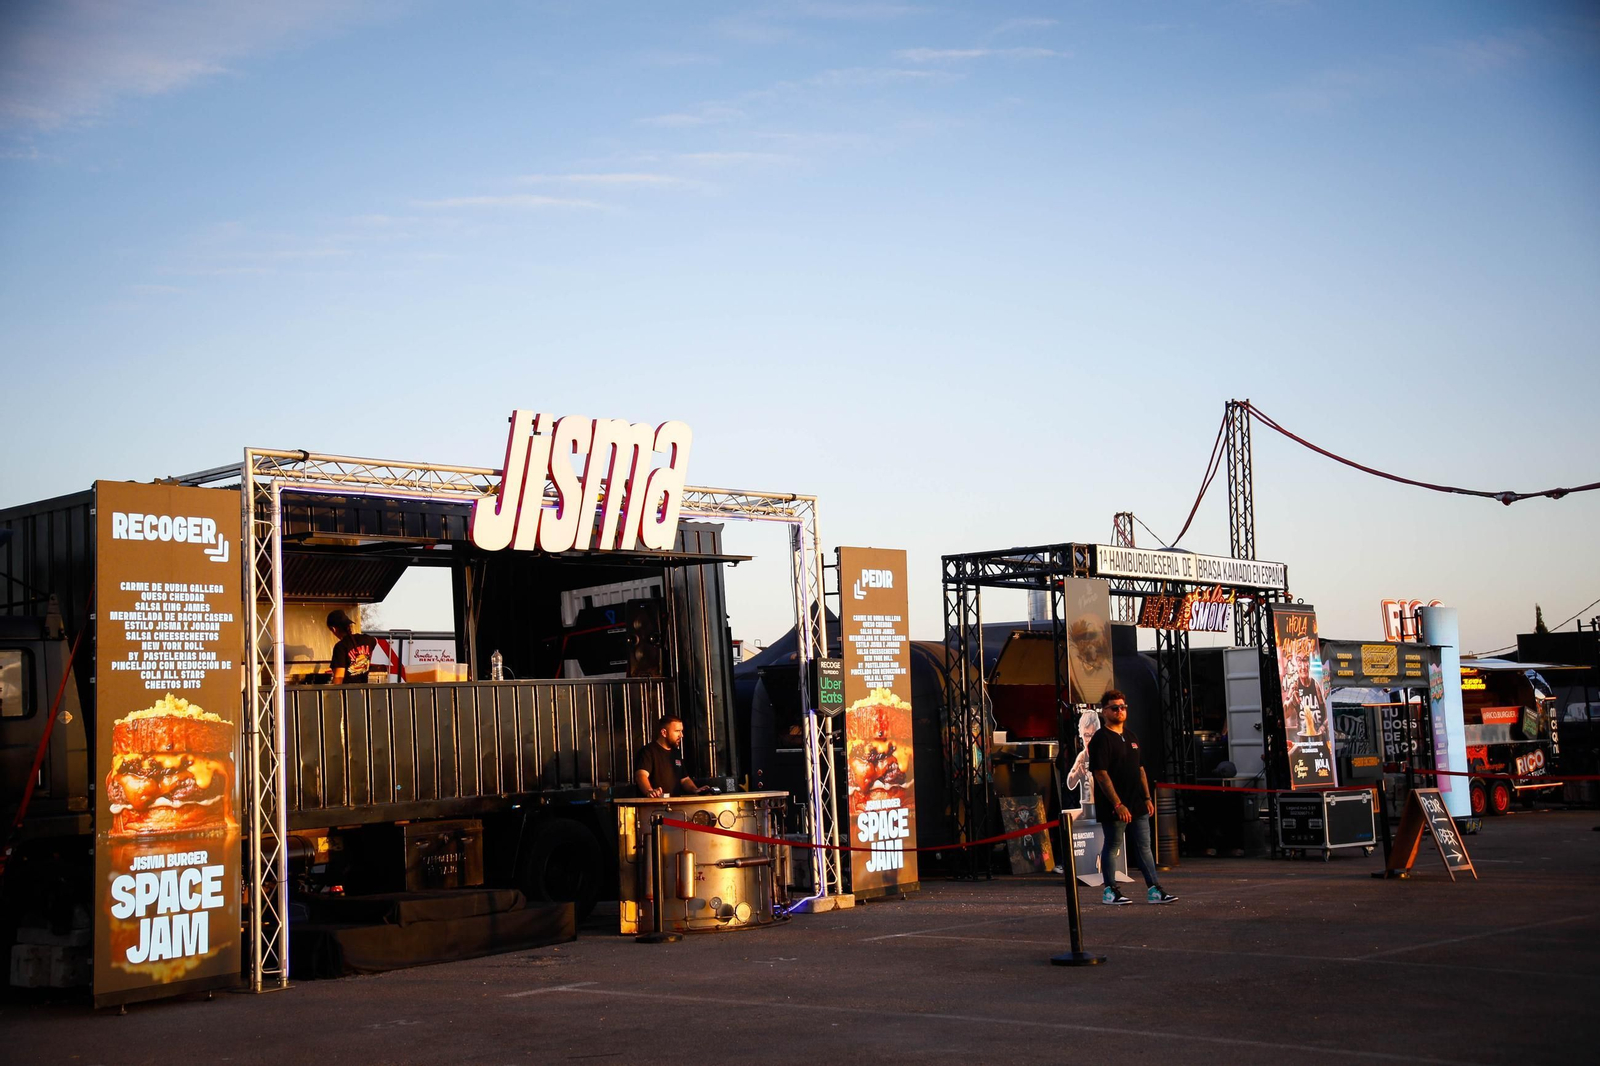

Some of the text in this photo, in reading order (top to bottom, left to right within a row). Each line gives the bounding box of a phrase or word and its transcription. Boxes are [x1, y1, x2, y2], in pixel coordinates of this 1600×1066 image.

[112, 512, 216, 544] RECOGER
[1110, 552, 1180, 576] HAMBURGUESERÍA
[1183, 558, 1192, 578] DE
[1199, 558, 1222, 580] BRASA
[1223, 562, 1251, 583] KAMADO
[1252, 565, 1261, 584] EN
[1262, 564, 1283, 586] ESPAÑA
[862, 569, 893, 588] PEDIR
[152, 583, 162, 591] DE
[165, 583, 187, 592] RUBIA
[190, 584, 223, 593] GALLEGA
[141, 592, 204, 602] QUESO CHEDDAR
[135, 602, 210, 612] SALSA KING JAMES
[110, 611, 233, 622] MERMELADA DE BACON CASERA
[1188, 600, 1232, 632] SMOKE
[1381, 598, 1445, 642] RIC
[125, 621, 220, 630] ESTILO JISMA X JORDAN
[126, 632, 219, 640] SALSA CHEESECHEETOS
[142, 642, 204, 650] NEW YORK ROLL
[128, 652, 138, 660] BY
[112, 660, 231, 670] PINCELADO CON REDUCCIÓN DE
[141, 670, 205, 679] COLA ALL STARS
[145, 680, 201, 689] CHEETOS BITS
[820, 677, 842, 690] Uber
[820, 690, 842, 703] Eats
[1299, 710, 1321, 724] SKE
[1382, 708, 1398, 718] TU
[1385, 732, 1400, 742] DE
[1516, 749, 1544, 776] RICO
[858, 808, 909, 842] SPACE
[130, 851, 208, 871] JISMA BURGER
[866, 839, 904, 872] JAM
[111, 864, 224, 919] SPACE
[126, 911, 209, 964] JAM
